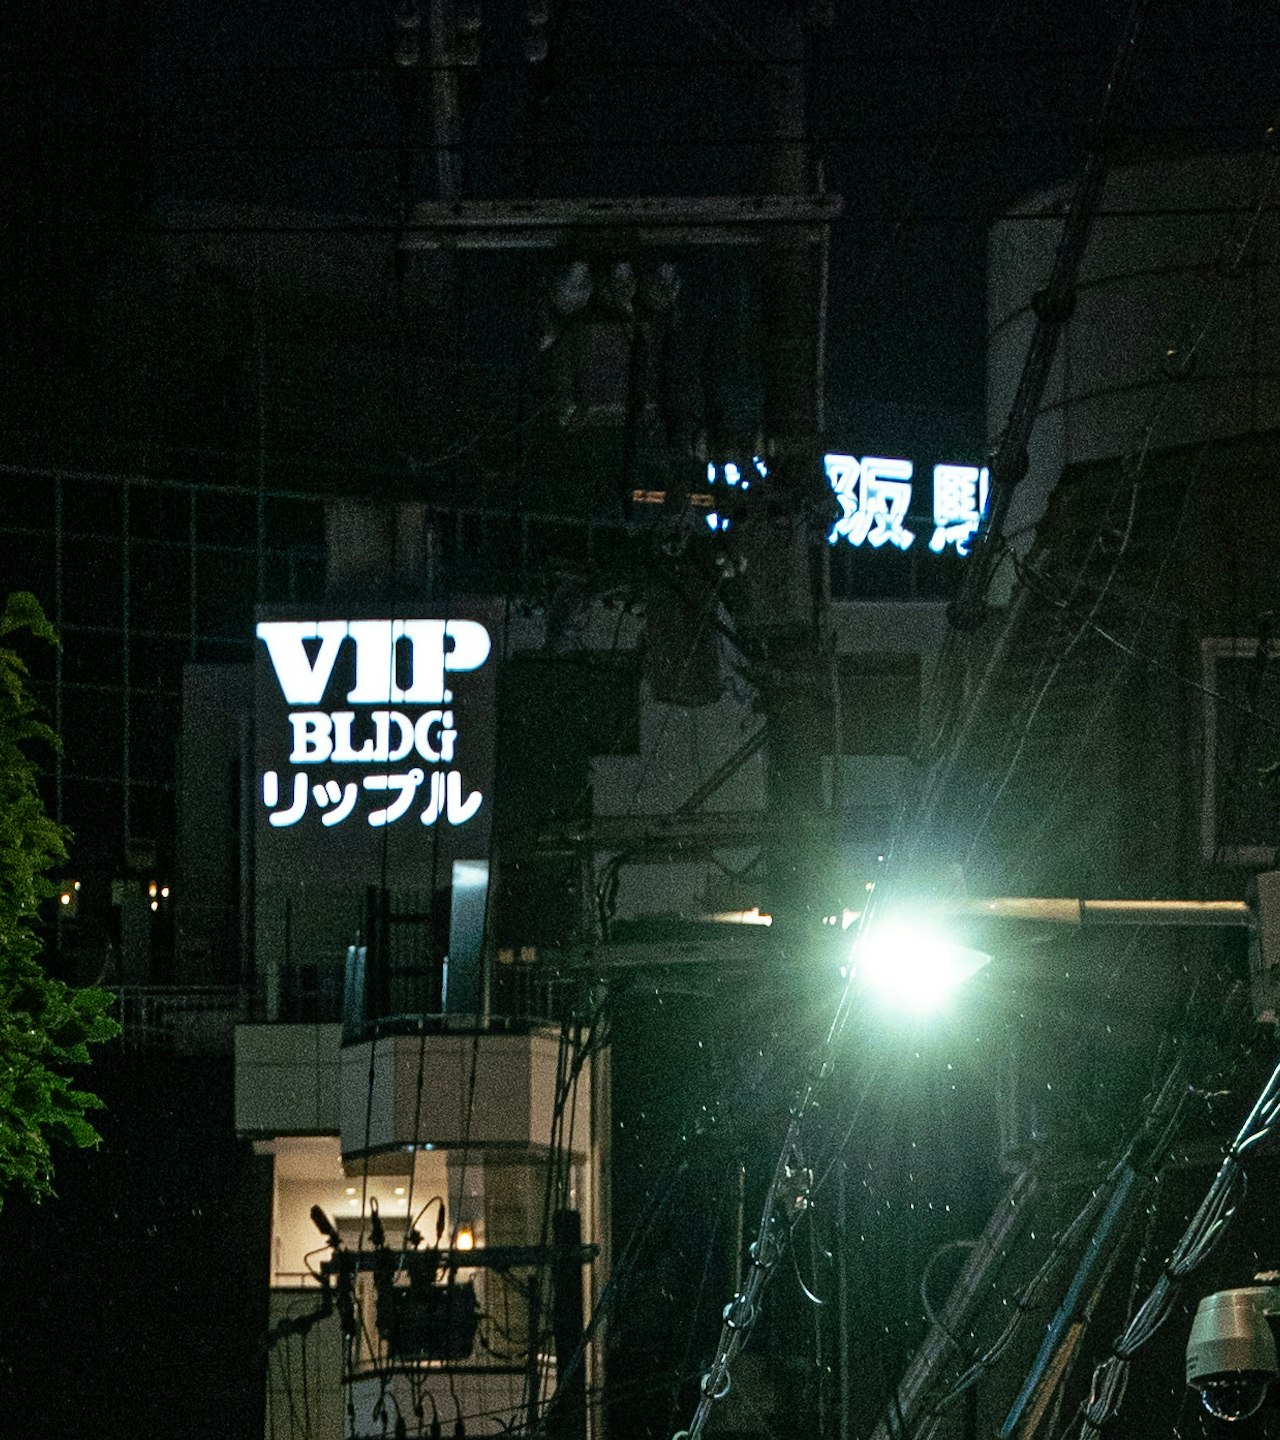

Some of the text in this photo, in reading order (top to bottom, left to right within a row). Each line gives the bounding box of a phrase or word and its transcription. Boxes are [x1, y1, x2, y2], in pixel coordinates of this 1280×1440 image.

[256, 619, 491, 705] VIP
[288, 709, 459, 765] BLDG
[263, 767, 483, 828] リップル
